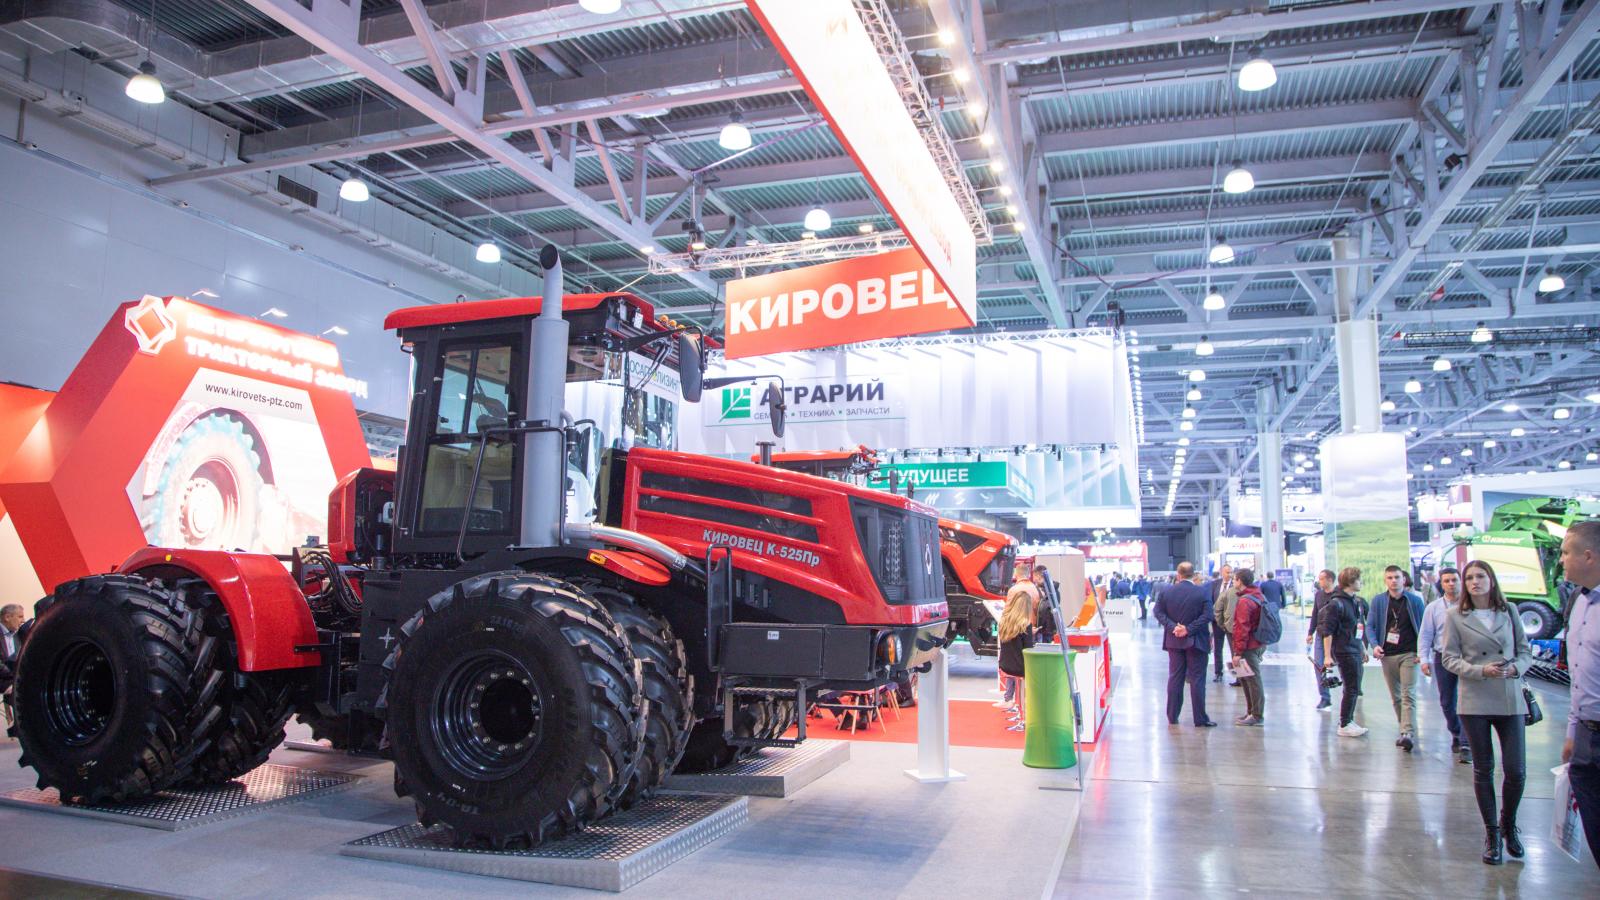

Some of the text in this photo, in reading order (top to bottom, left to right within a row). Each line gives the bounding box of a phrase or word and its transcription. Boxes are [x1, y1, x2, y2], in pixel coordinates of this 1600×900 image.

[205, 383, 303, 410] www.kirovets-ptz.com
[799, 409, 835, 419] ТЕХНИКА
[846, 407, 890, 417] ЗАПЧАСТИ
[703, 529, 820, 567] КИРОВЕЦ К-525Пр
